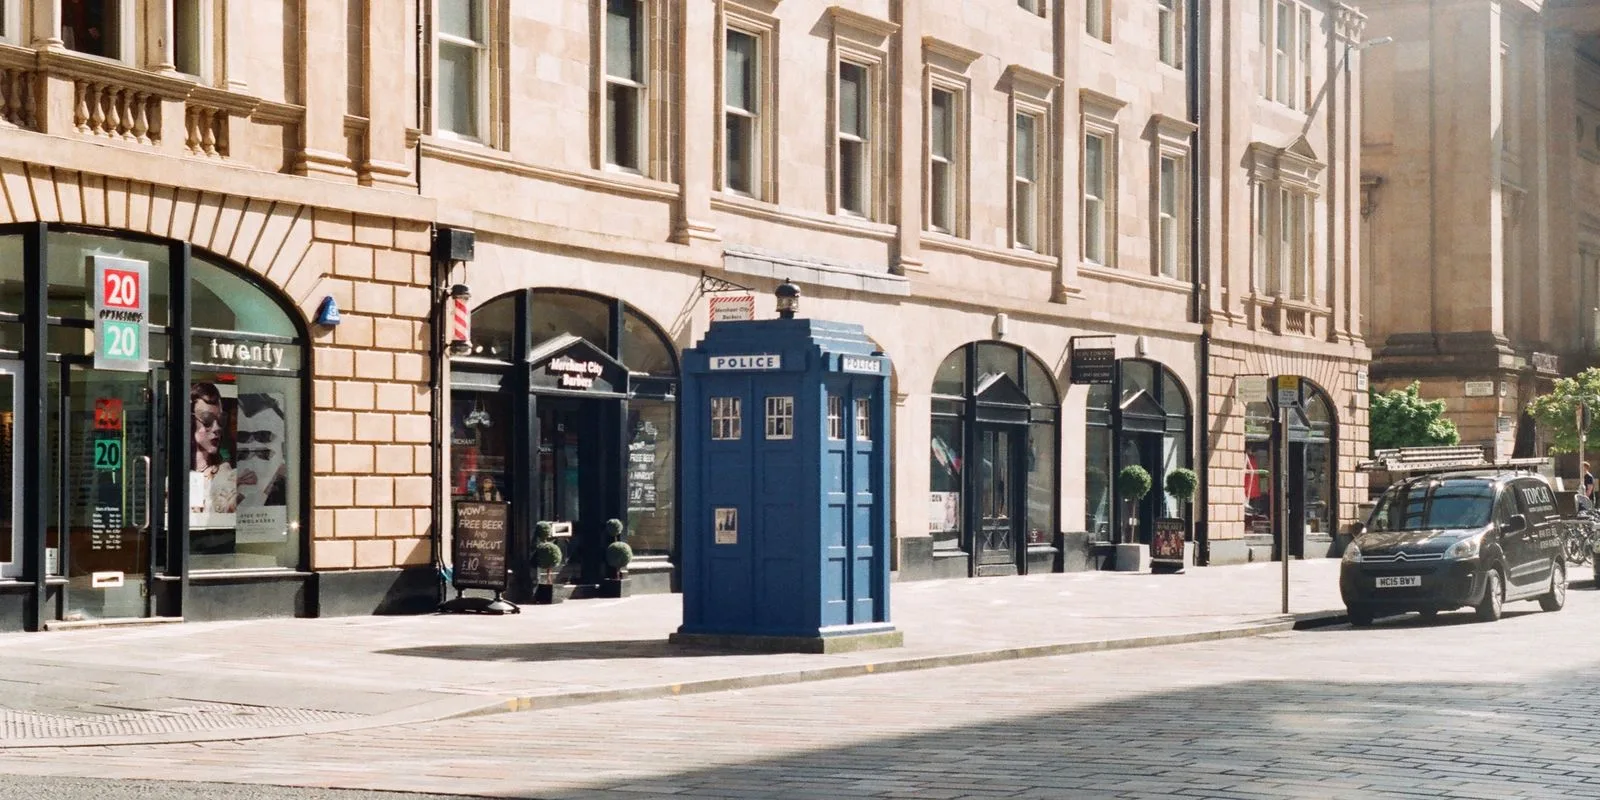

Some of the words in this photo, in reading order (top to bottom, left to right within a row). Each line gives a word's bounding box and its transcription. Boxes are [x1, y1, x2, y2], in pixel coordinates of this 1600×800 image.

[107, 273, 136, 306] 20
[107, 325, 136, 357] 20
[210, 338, 284, 368] twenty
[717, 356, 774, 368] POLICE
[550, 358, 587, 373] Merchant
[587, 361, 604, 377] City
[847, 358, 877, 371] POLICE
[563, 373, 593, 388] Barbers
[96, 442, 120, 466] 20
[1522, 486, 1550, 505] TOPCAT
[459, 520, 481, 529] FREE
[482, 520, 504, 530] BEER
[466, 540, 503, 550] HAIRCUT
